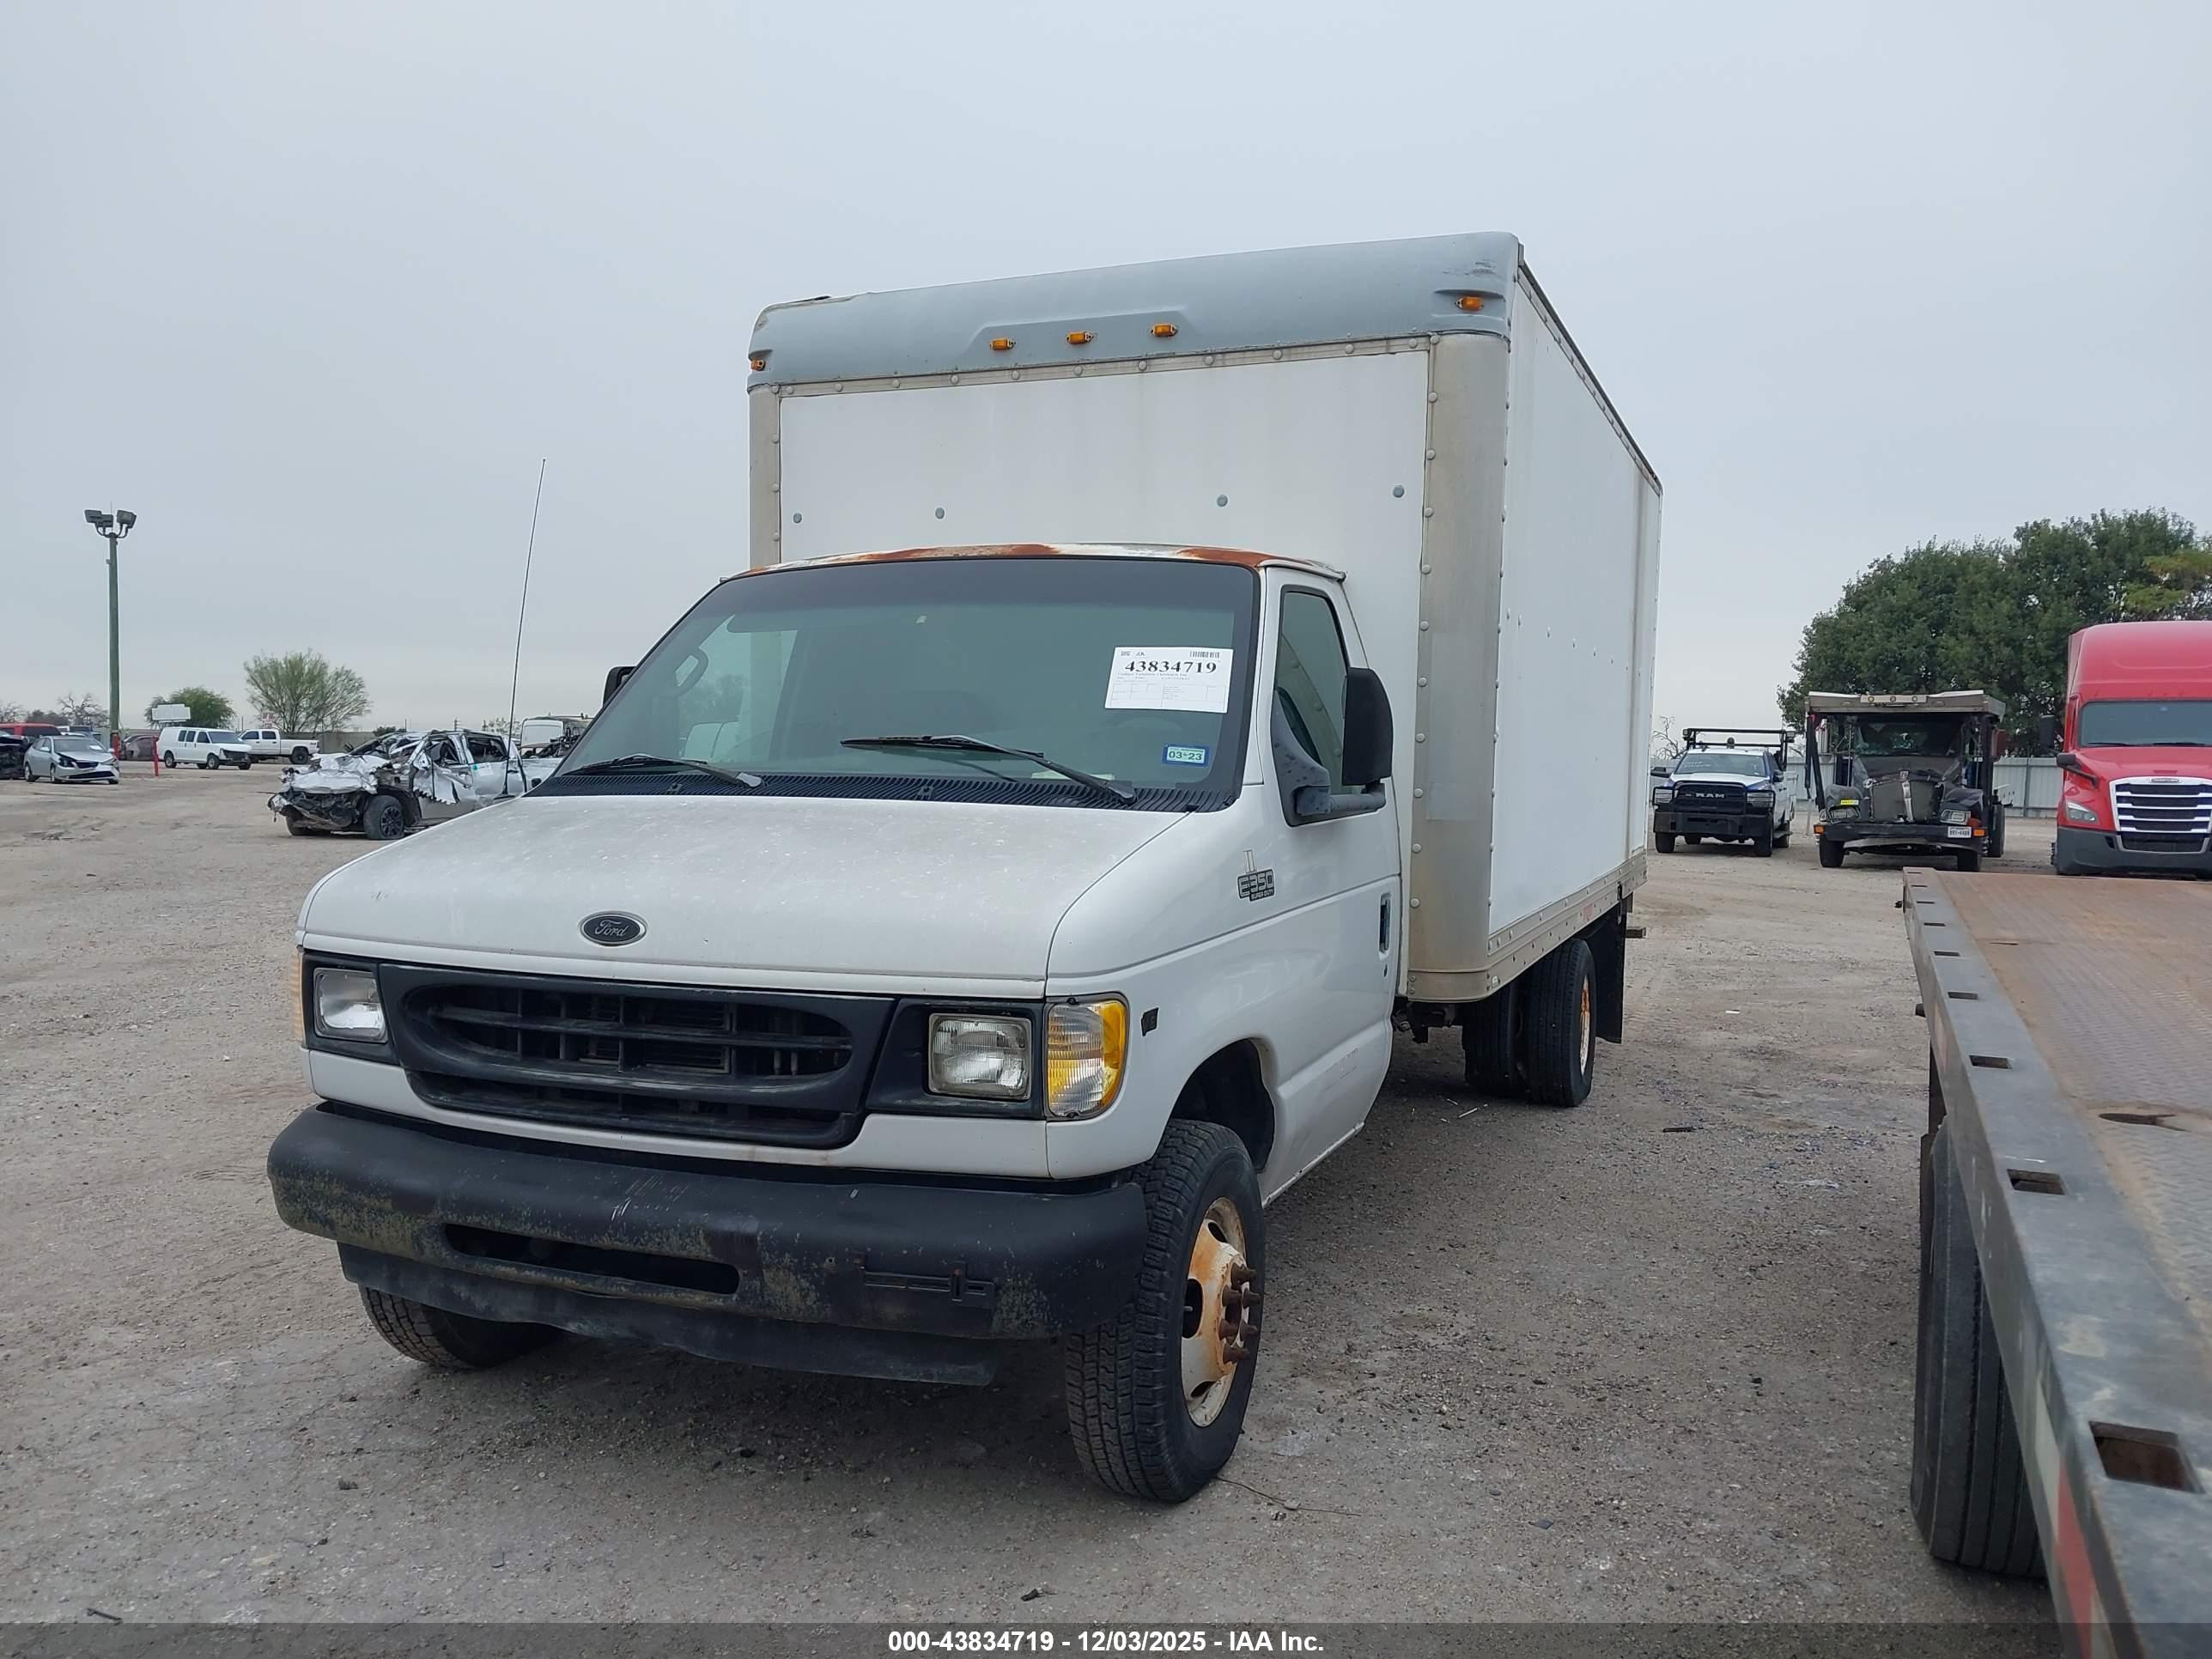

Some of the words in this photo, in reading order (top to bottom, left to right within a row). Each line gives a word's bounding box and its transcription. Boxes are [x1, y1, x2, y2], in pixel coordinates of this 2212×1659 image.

[1124, 660, 1217, 673] 43834719
[1238, 871, 1273, 897] E350
[594, 919, 629, 937] Ford
